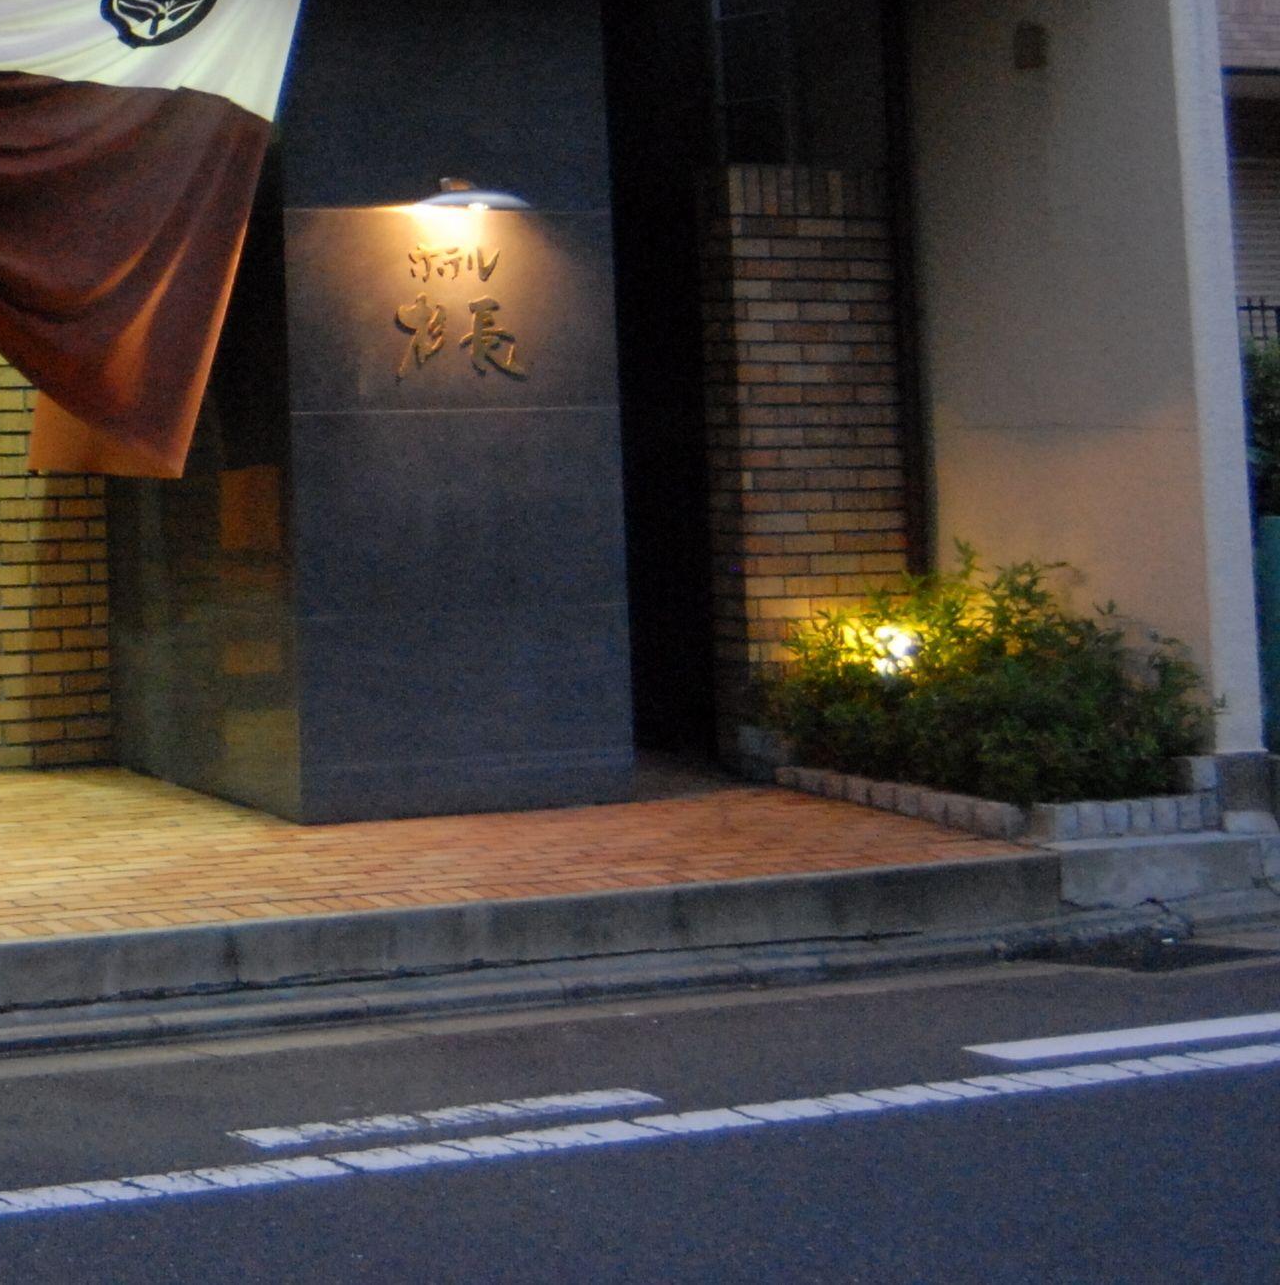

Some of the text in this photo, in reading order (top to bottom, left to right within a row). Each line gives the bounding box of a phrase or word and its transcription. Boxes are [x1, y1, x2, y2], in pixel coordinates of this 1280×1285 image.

[408, 246, 501, 282] ホテル
[395, 292, 528, 385] 杉長
